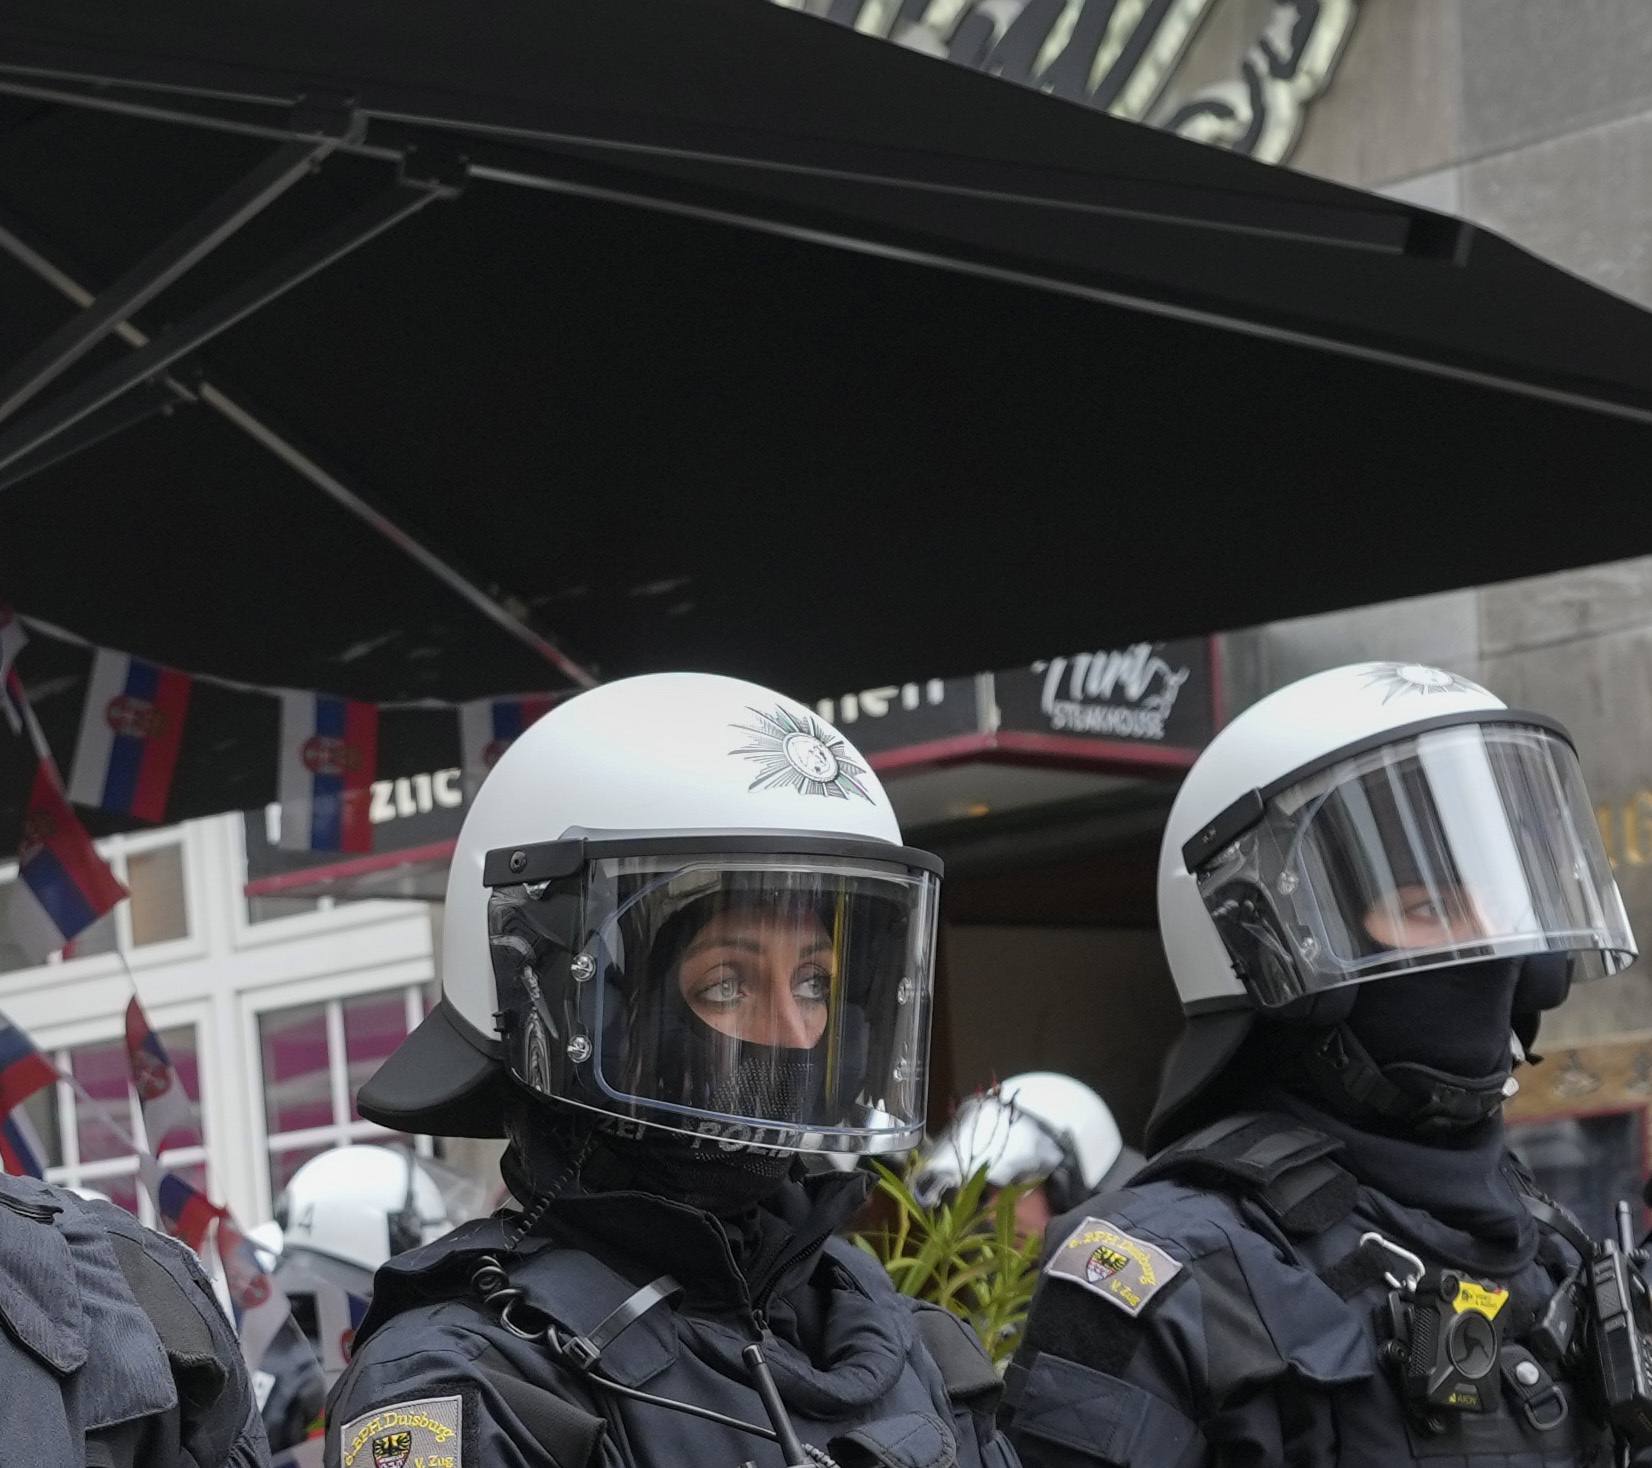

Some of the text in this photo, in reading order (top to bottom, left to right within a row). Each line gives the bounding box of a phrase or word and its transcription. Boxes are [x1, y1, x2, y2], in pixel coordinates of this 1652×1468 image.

[1050, 700, 1165, 740] STEAKHOUSE
[383, 1411, 455, 1443] Duisburg
[428, 1454, 454, 1468] Zug
